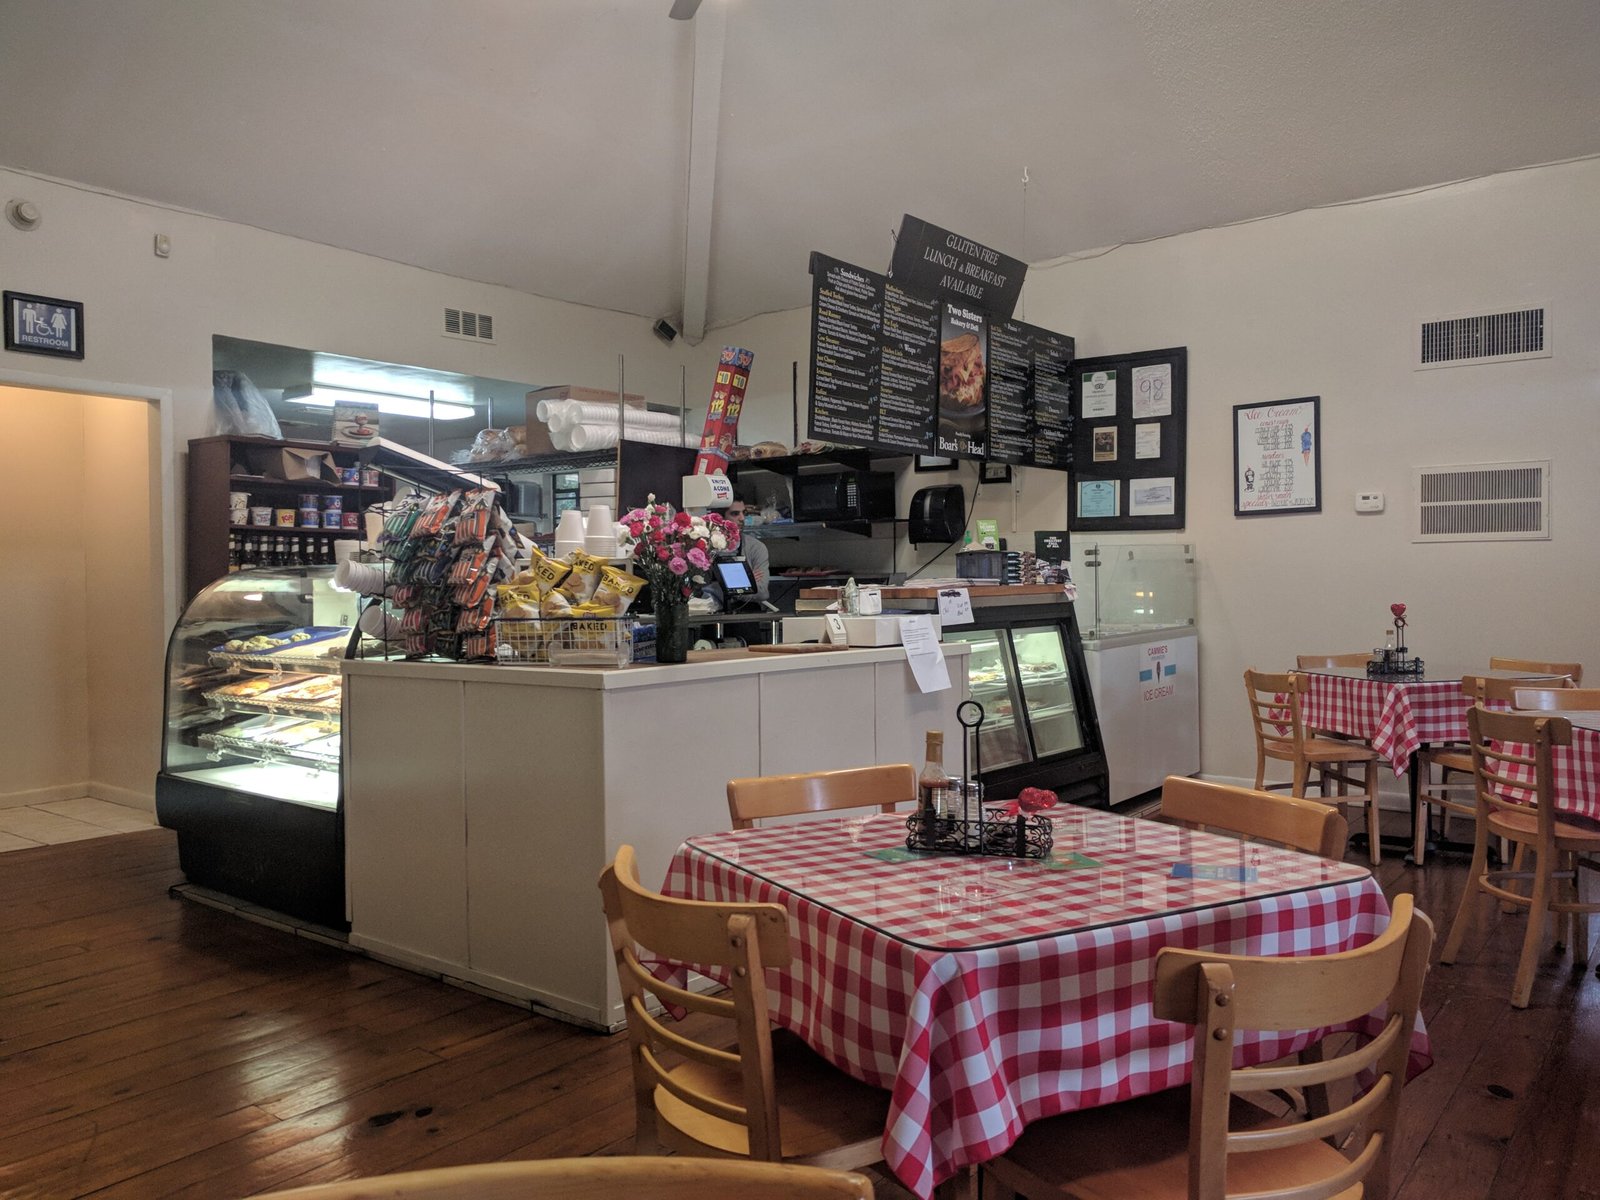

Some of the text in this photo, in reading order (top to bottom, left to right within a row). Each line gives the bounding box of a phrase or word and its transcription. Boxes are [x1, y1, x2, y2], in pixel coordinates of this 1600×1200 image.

[946, 234, 1000, 266] GLUTEN FREE
[923, 246, 1007, 288] LUNCH & BREAKFAST
[939, 275, 985, 300] AVAILABLE
[947, 303, 983, 324] Two Sisters
[22, 334, 69, 347] RESTROOM
[1140, 379, 1164, 404] 98
[939, 436, 959, 452] Boar's
[967, 440, 984, 456] Head
[571, 622, 608, 631] BAKED
[1144, 688, 1154, 702] ICE
